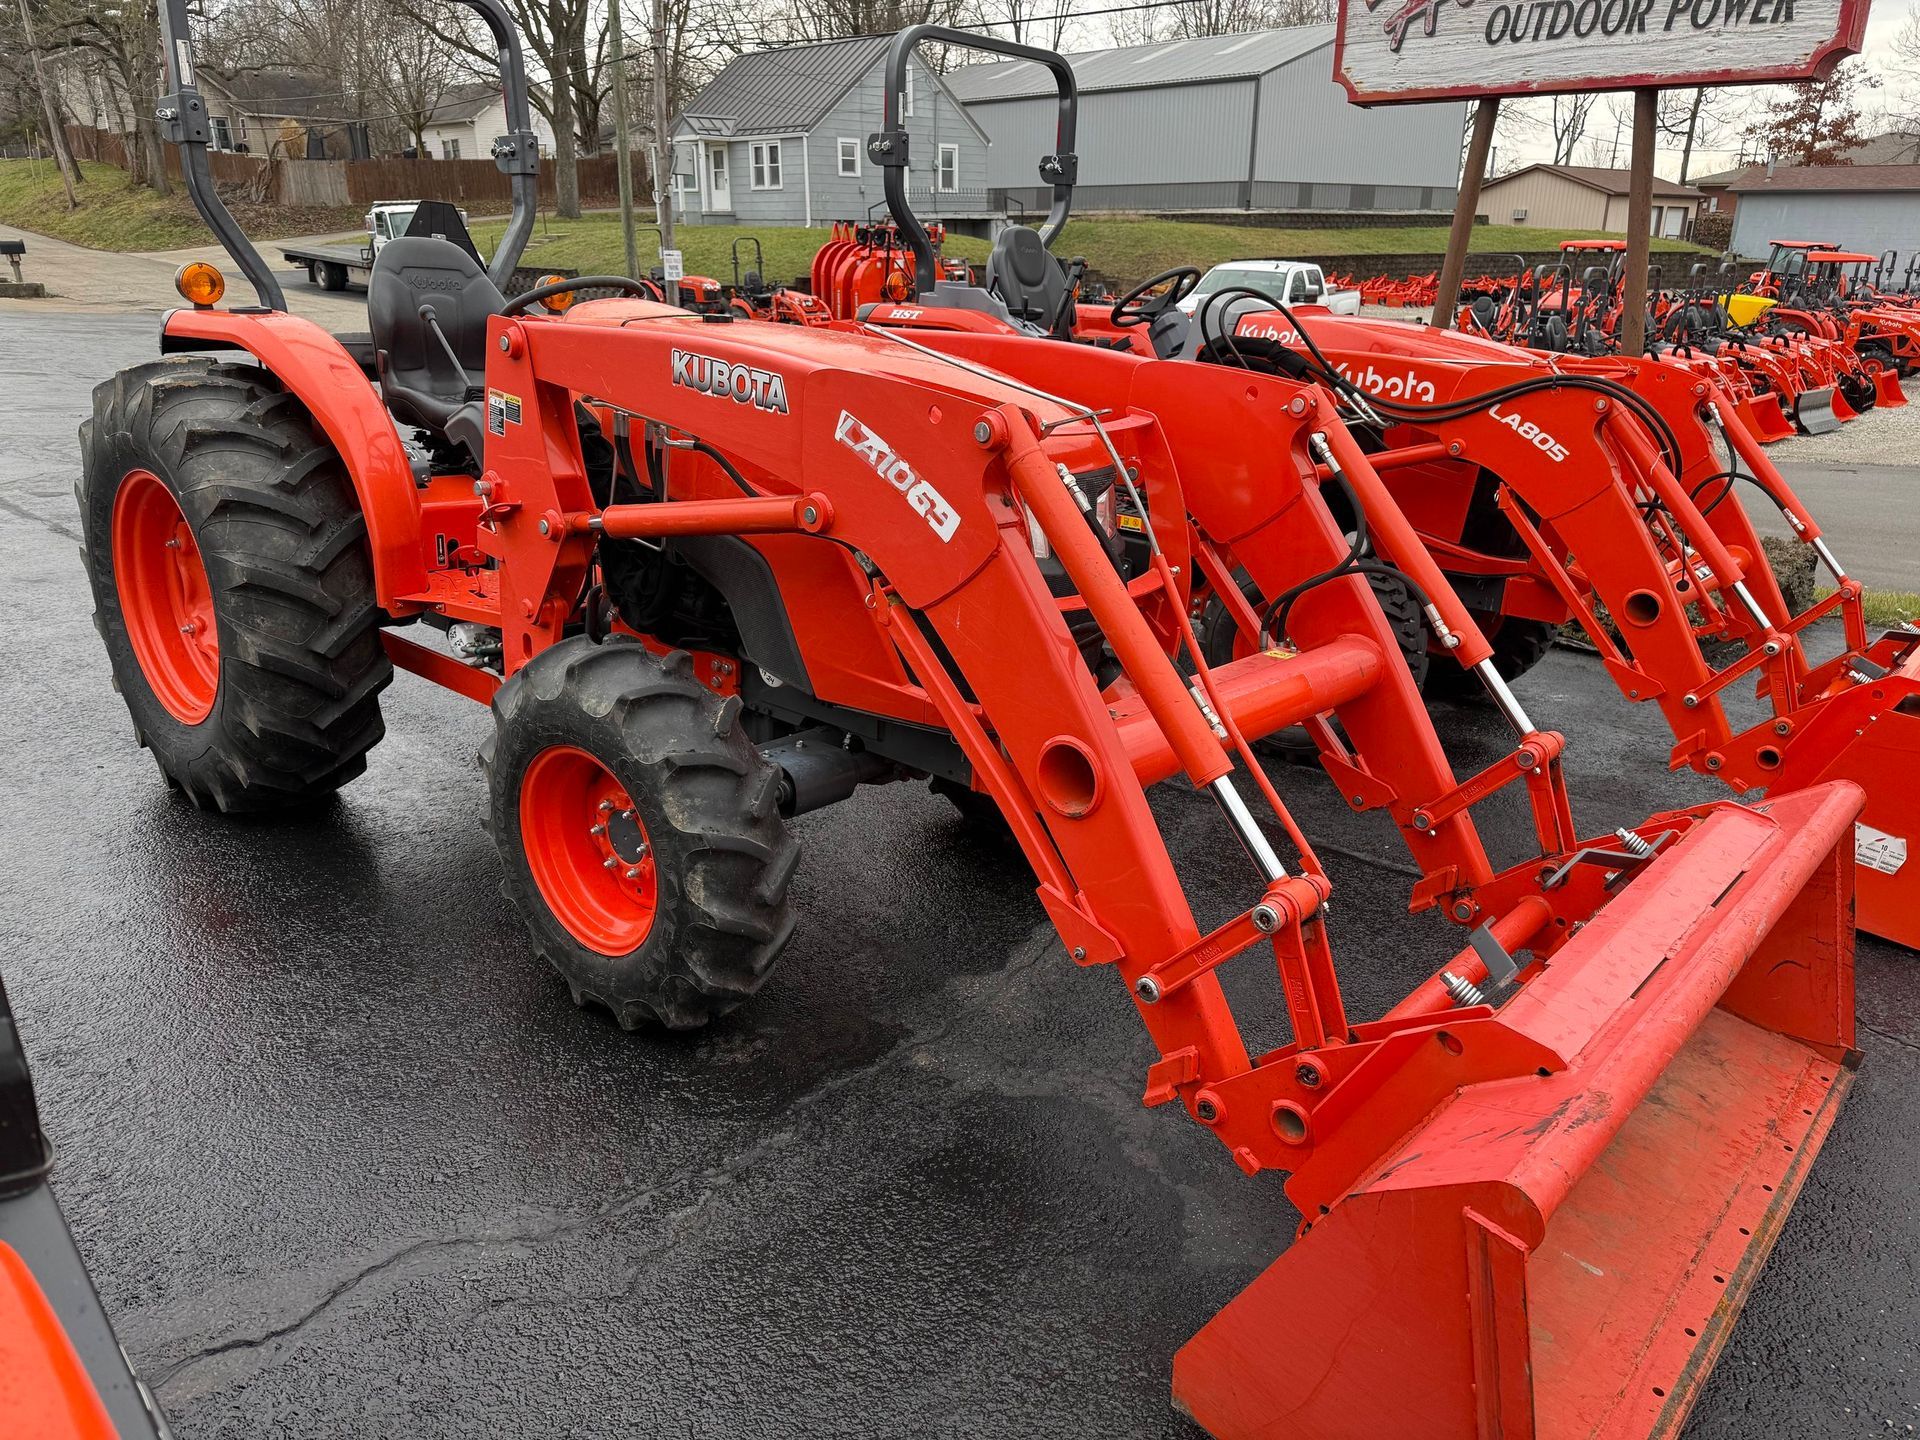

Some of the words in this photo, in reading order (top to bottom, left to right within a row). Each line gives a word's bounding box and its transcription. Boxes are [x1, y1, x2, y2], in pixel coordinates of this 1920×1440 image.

[1485, 0, 1652, 45] OUTDOOR
[1662, 0, 1798, 31] POWER
[407, 274, 463, 291] Kubota
[888, 309, 925, 320] HST
[1240, 323, 1306, 345] Kubot
[671, 347, 790, 416] KUBOTA
[1488, 403, 1570, 463] LA805
